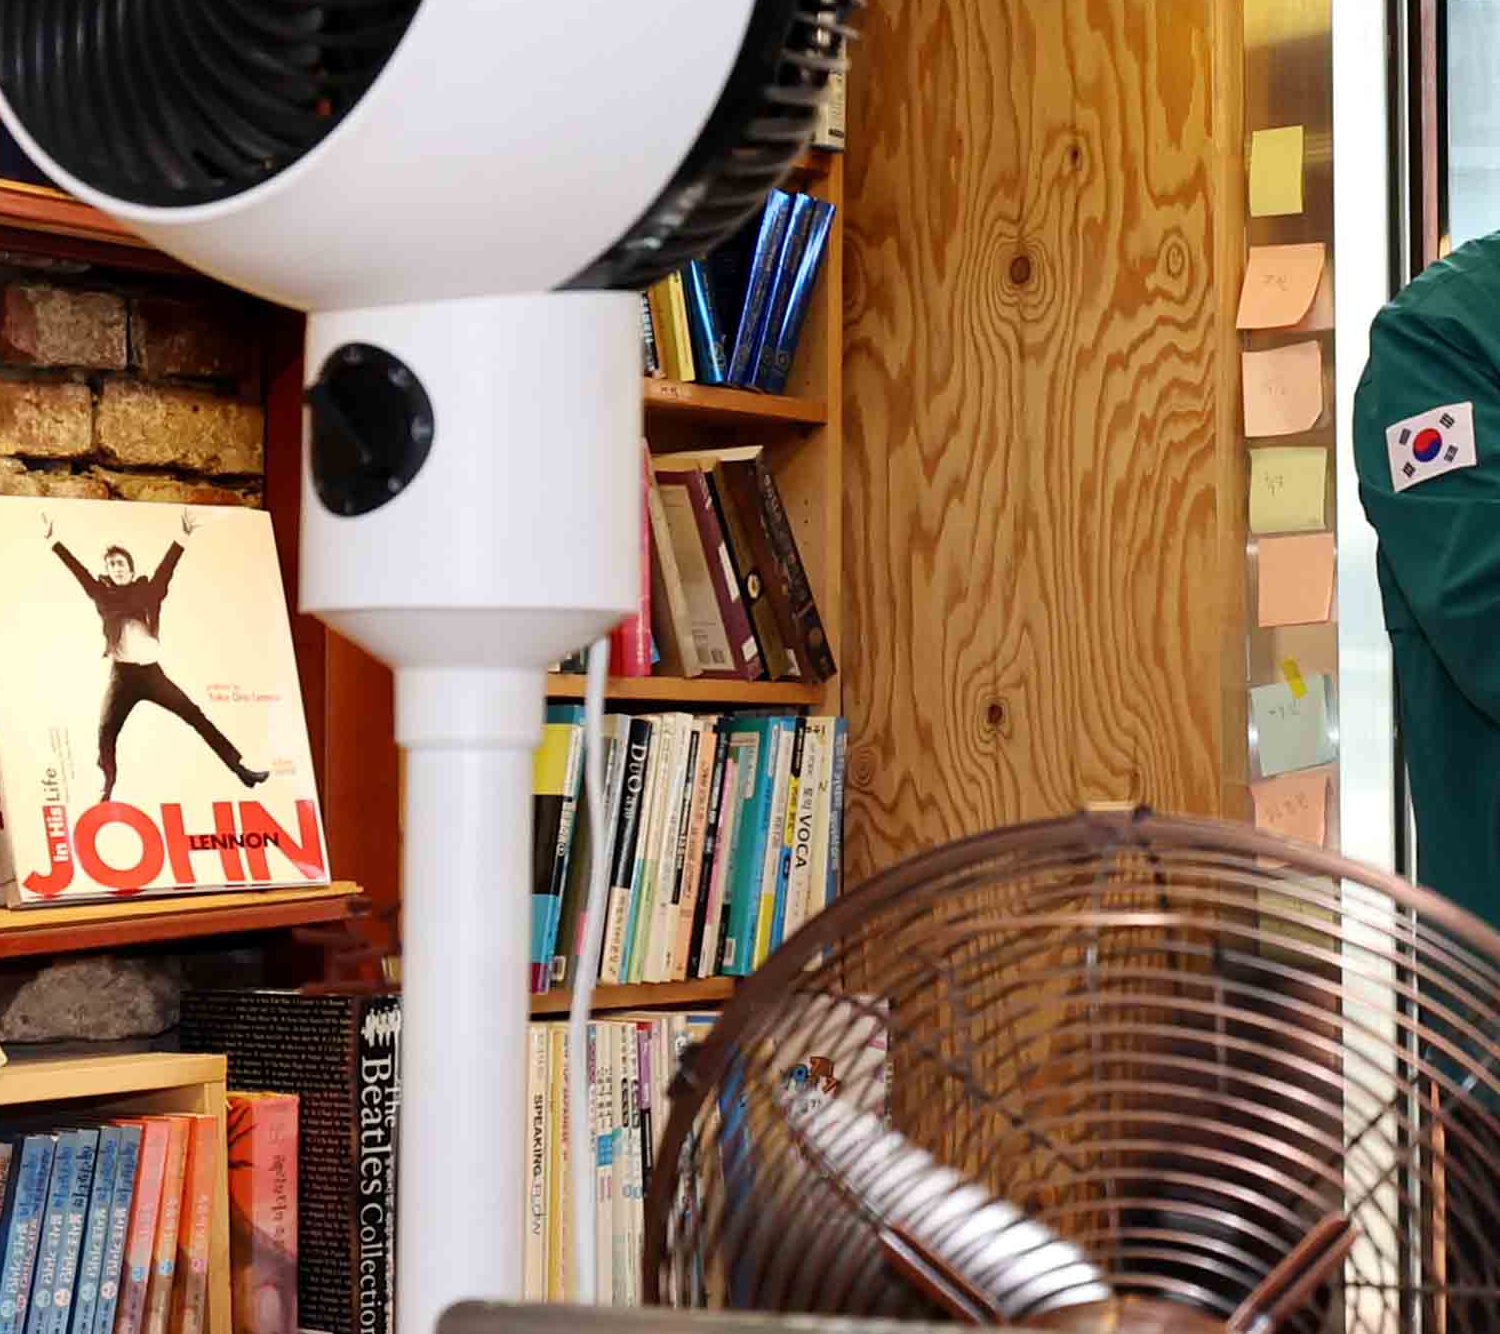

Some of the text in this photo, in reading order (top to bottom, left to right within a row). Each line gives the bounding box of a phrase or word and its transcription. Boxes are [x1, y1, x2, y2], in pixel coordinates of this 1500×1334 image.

[43, 765, 60, 805] Life
[22, 798, 326, 899] JOHN
[49, 806, 69, 840] His
[189, 831, 280, 852] LENNON
[795, 815, 813, 869] VOCA
[360, 1052, 392, 1198] Beatles
[384, 1073, 401, 1130] The
[529, 1092, 544, 1177] SPEAKING
